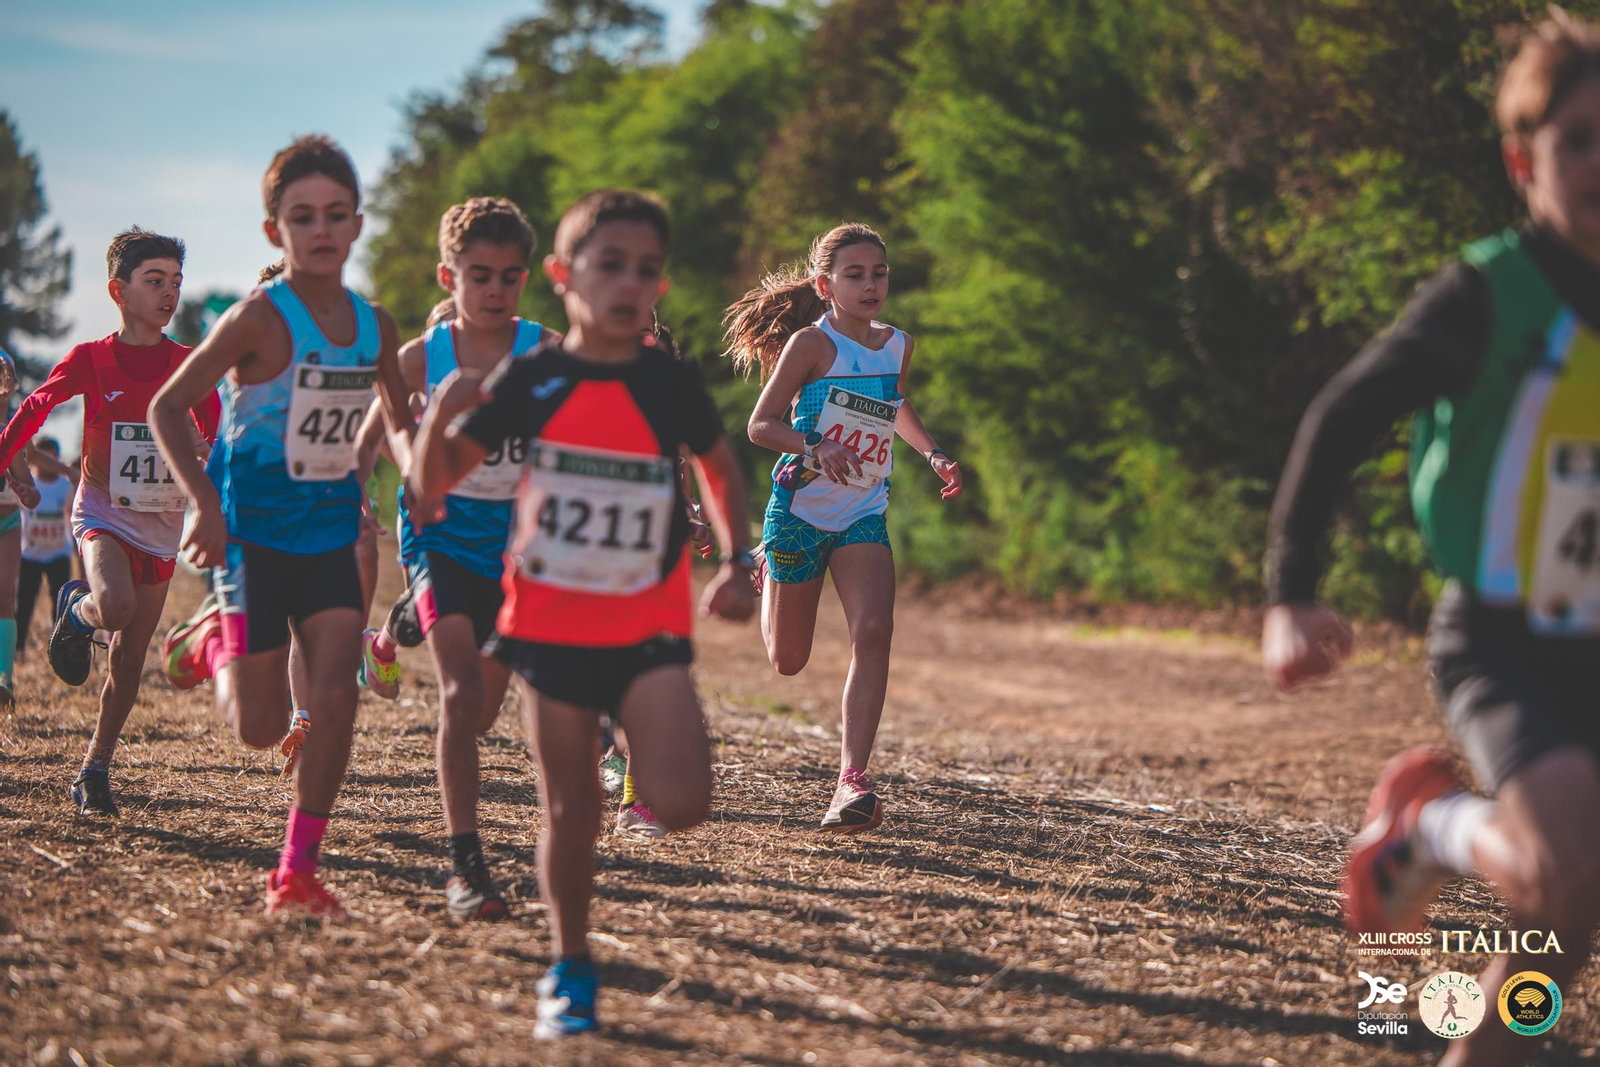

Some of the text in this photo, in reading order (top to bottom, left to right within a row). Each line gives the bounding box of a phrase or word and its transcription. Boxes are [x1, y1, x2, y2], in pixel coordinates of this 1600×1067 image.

[853, 398, 889, 417] ITÁLICA
[823, 423, 891, 466] 4426
[119, 454, 176, 484] 411
[539, 494, 655, 550] 4211
